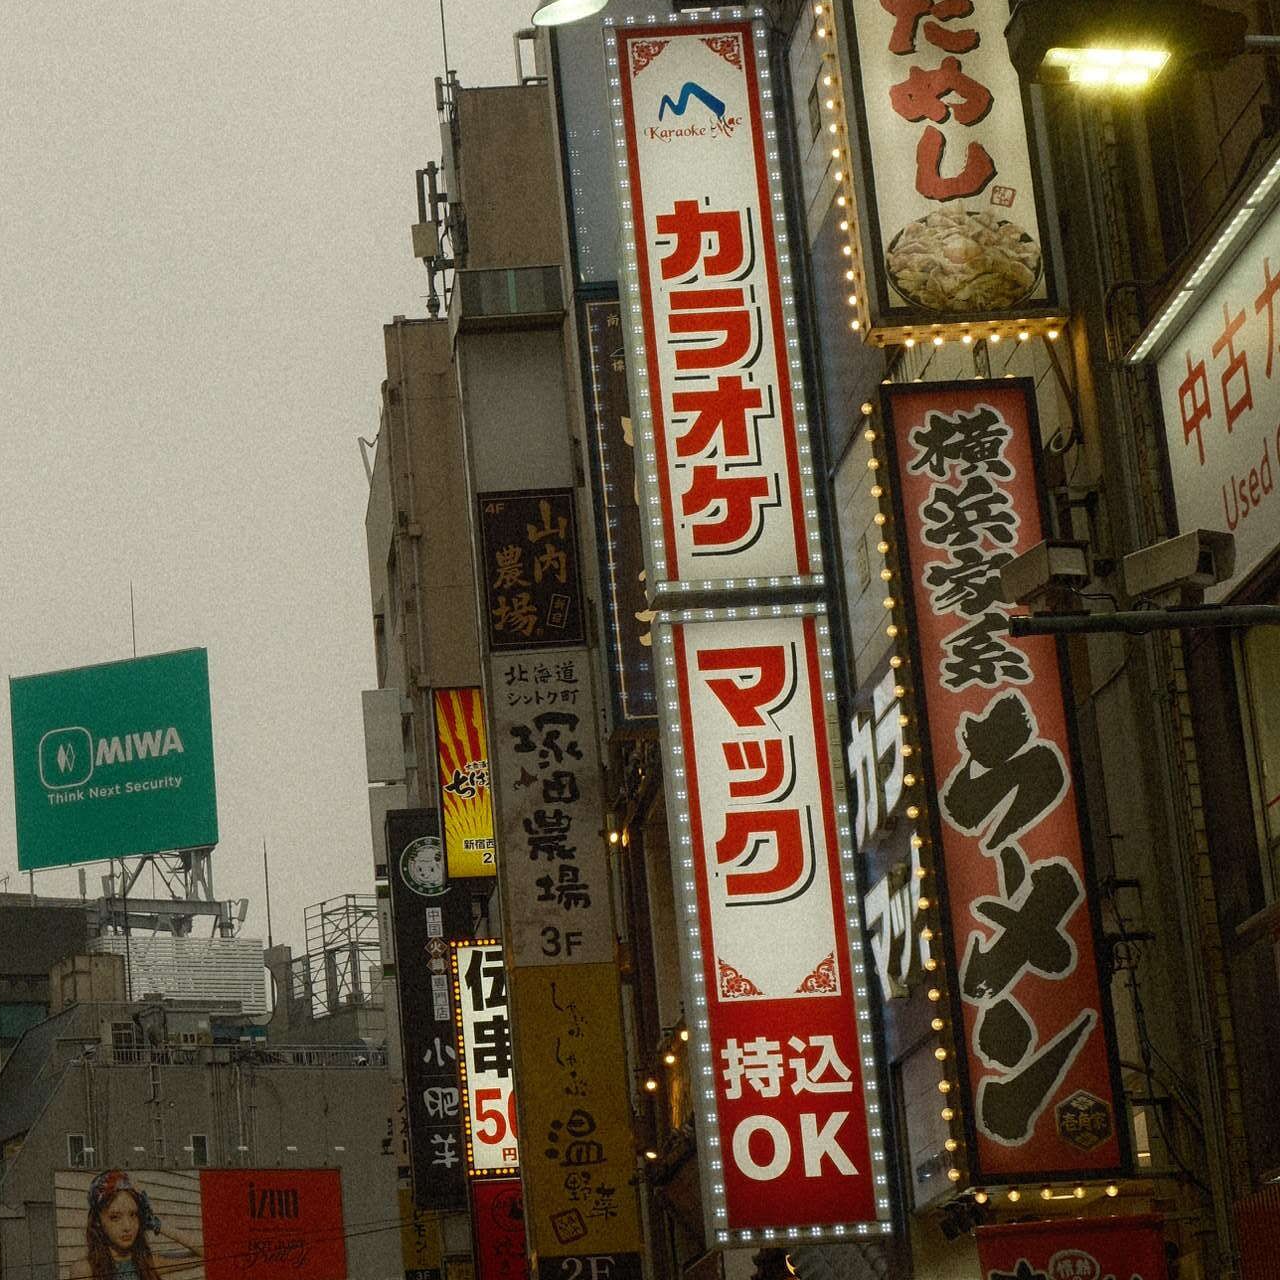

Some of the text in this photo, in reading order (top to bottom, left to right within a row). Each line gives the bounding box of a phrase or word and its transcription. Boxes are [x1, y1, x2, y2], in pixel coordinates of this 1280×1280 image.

[643, 114, 743, 143] Karaoke Mac
[655, 199, 781, 556] カラオケ
[1223, 452, 1273, 530] Used
[527, 500, 569, 583] 山内
[492, 545, 538, 637] 農場
[505, 661, 578, 685] 北海道
[508, 690, 579, 706] シントク町
[95, 726, 184, 766] MIWA
[698, 642, 816, 907] マック
[906, 404, 1097, 1147] 横浜家系 ラーメン
[47, 775, 183, 806] Think Next Security
[542, 927, 582, 956] 3F
[721, 1036, 853, 1099] 持込
[732, 1111, 859, 1182] OK
